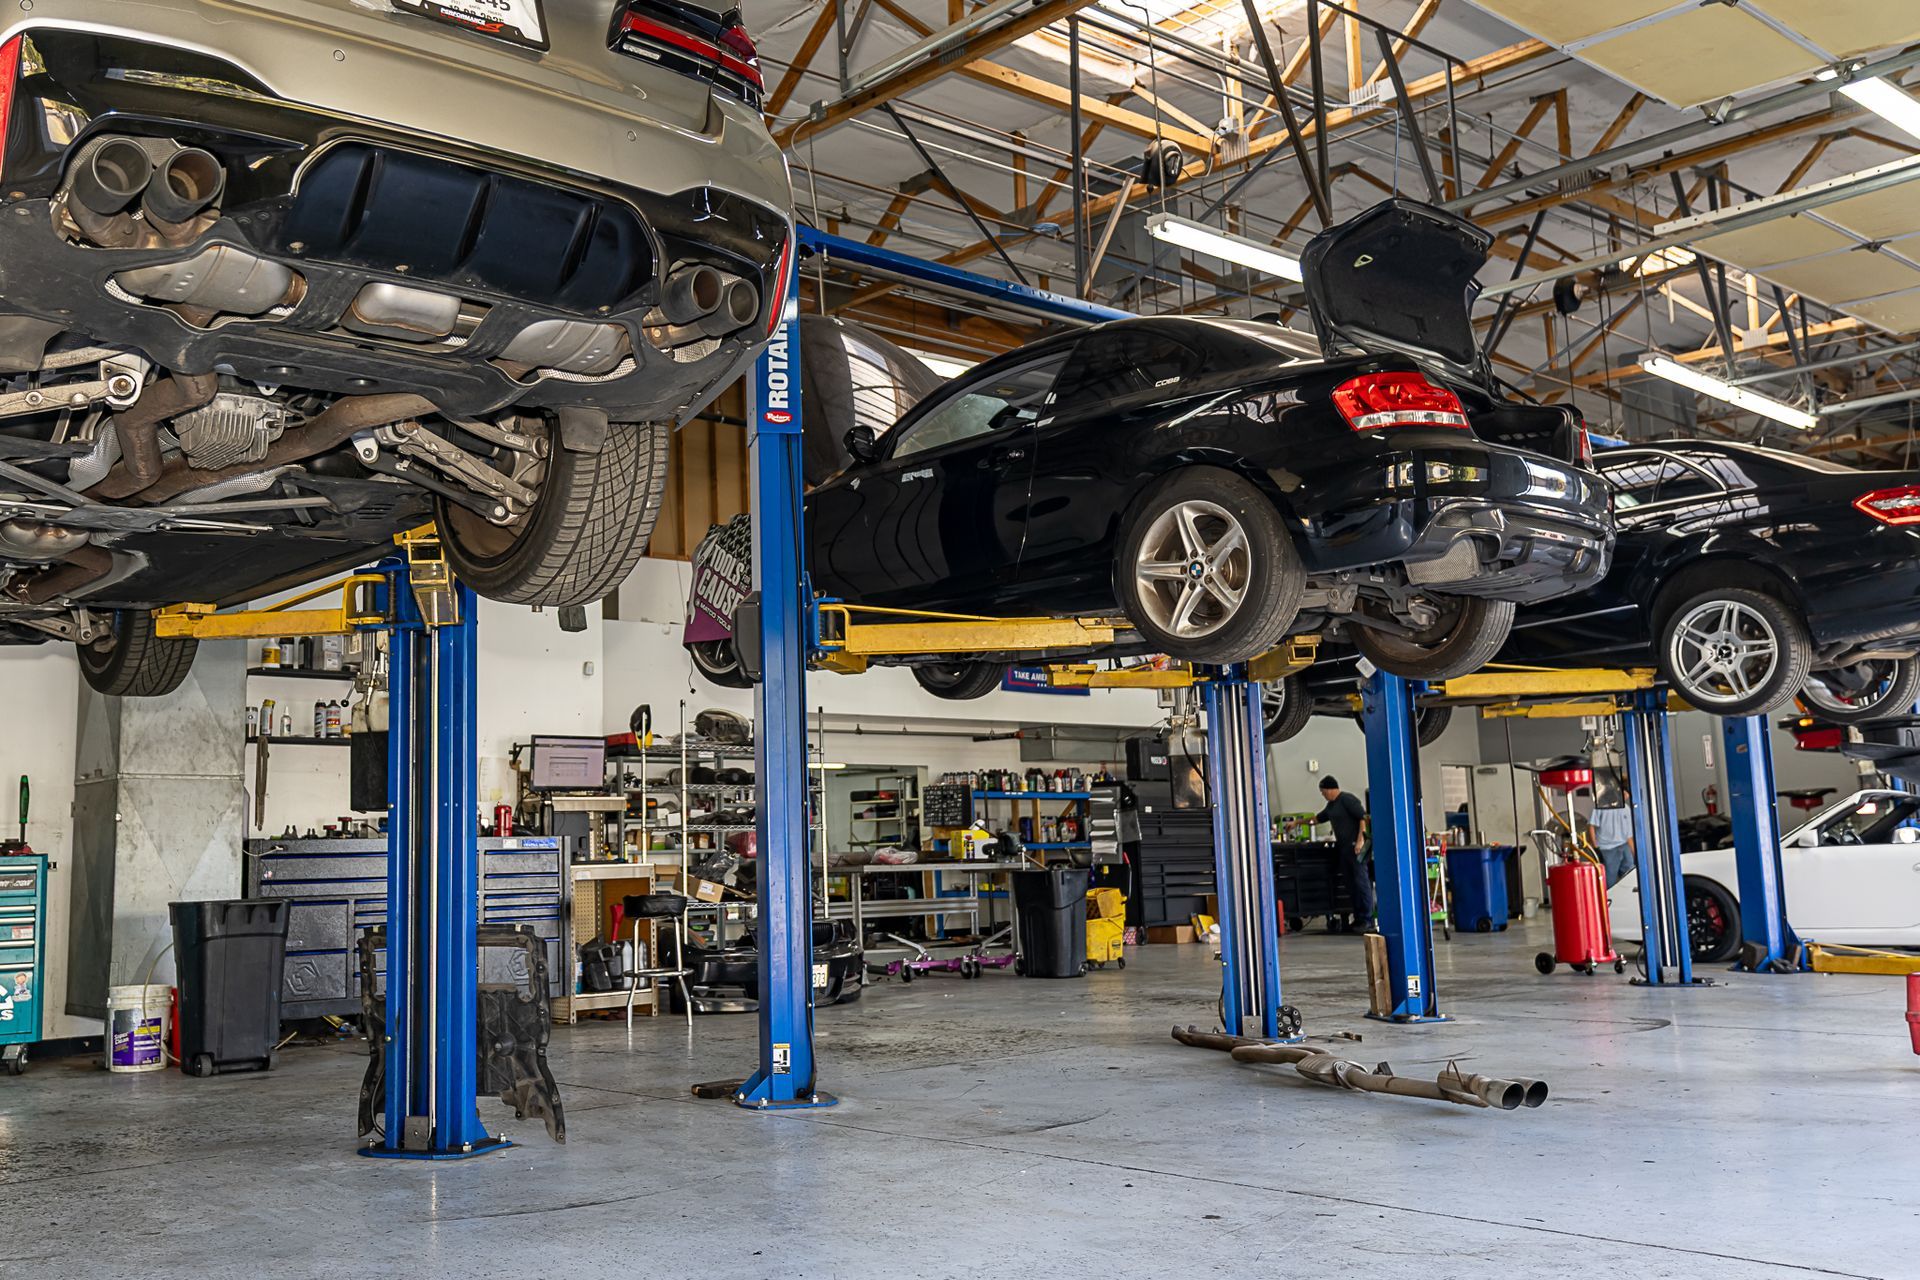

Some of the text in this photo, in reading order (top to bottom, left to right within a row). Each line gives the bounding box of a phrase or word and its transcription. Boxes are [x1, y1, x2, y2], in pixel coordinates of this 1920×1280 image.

[710, 543, 745, 586] TOOLS
[697, 568, 744, 620] CAUSE
[1014, 670, 1030, 680] TAKE
